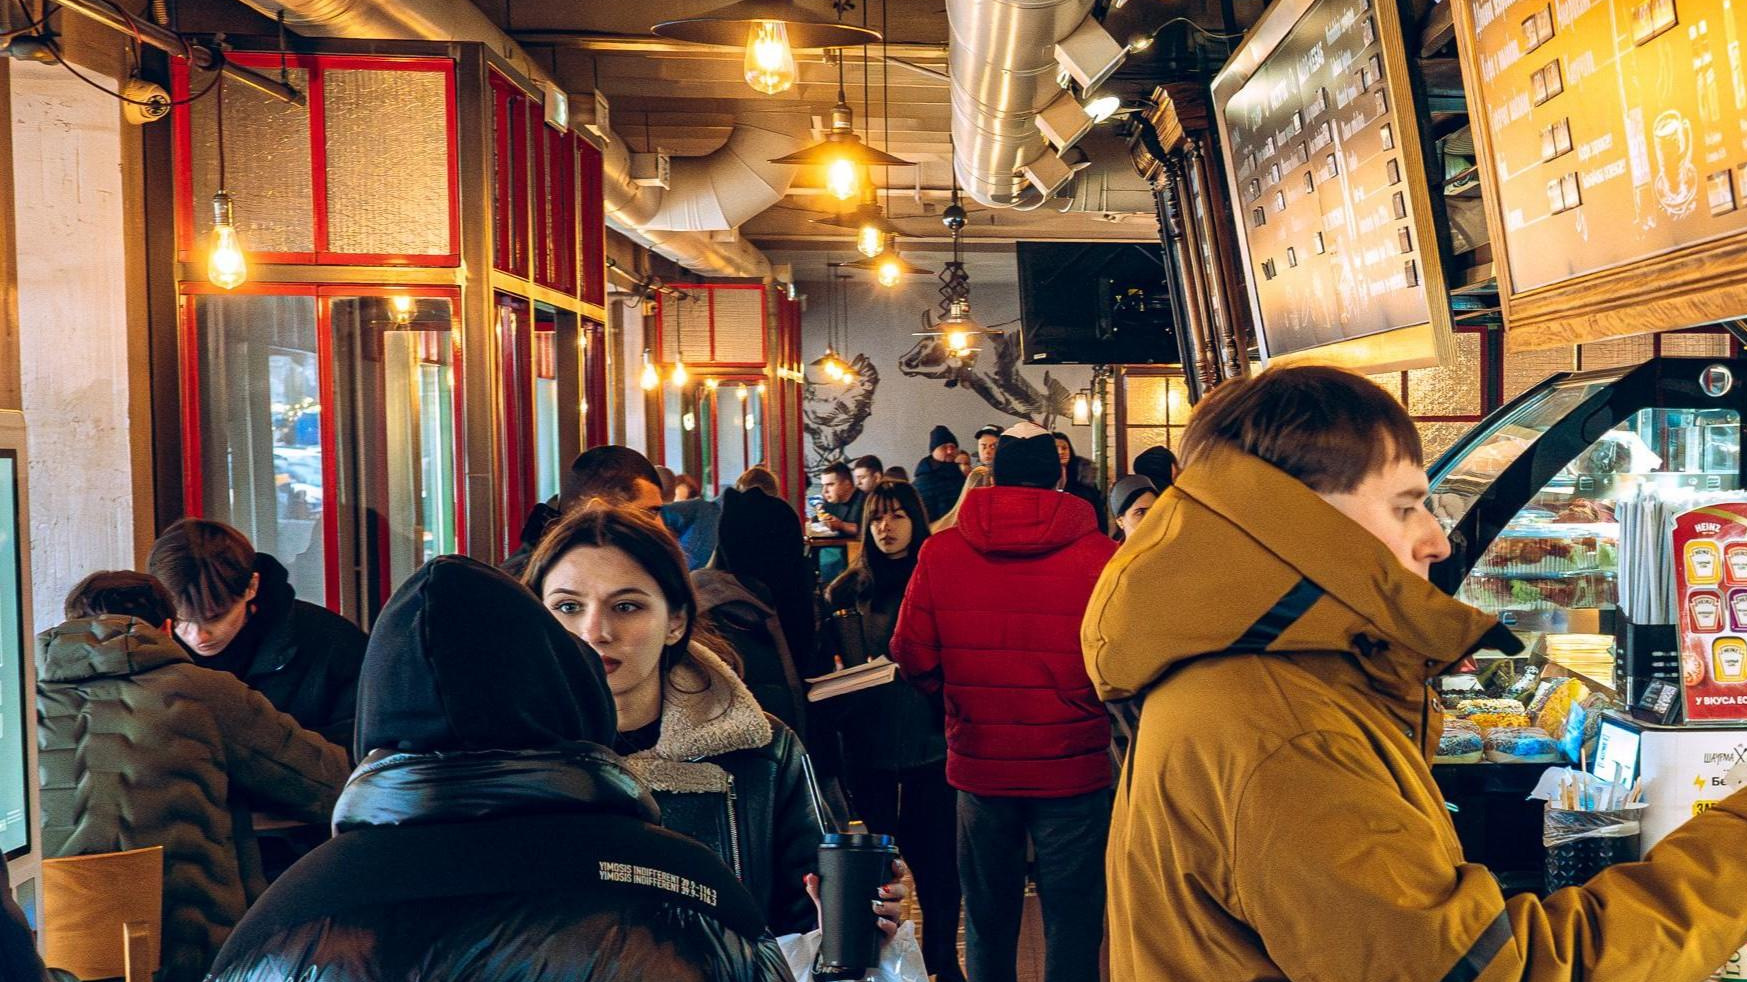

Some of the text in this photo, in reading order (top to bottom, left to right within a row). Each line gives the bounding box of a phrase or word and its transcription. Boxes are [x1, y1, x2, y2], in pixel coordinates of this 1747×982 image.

[1694, 522, 1721, 533] HEINZ
[1695, 697, 1703, 706] У
[1704, 696, 1736, 705] ВКУСА
[599, 861, 632, 874] YIMOSIS
[633, 865, 680, 884] INDIFFERENT
[599, 871, 632, 883] YIMOSIS
[633, 875, 680, 893] INDIFFERENT
